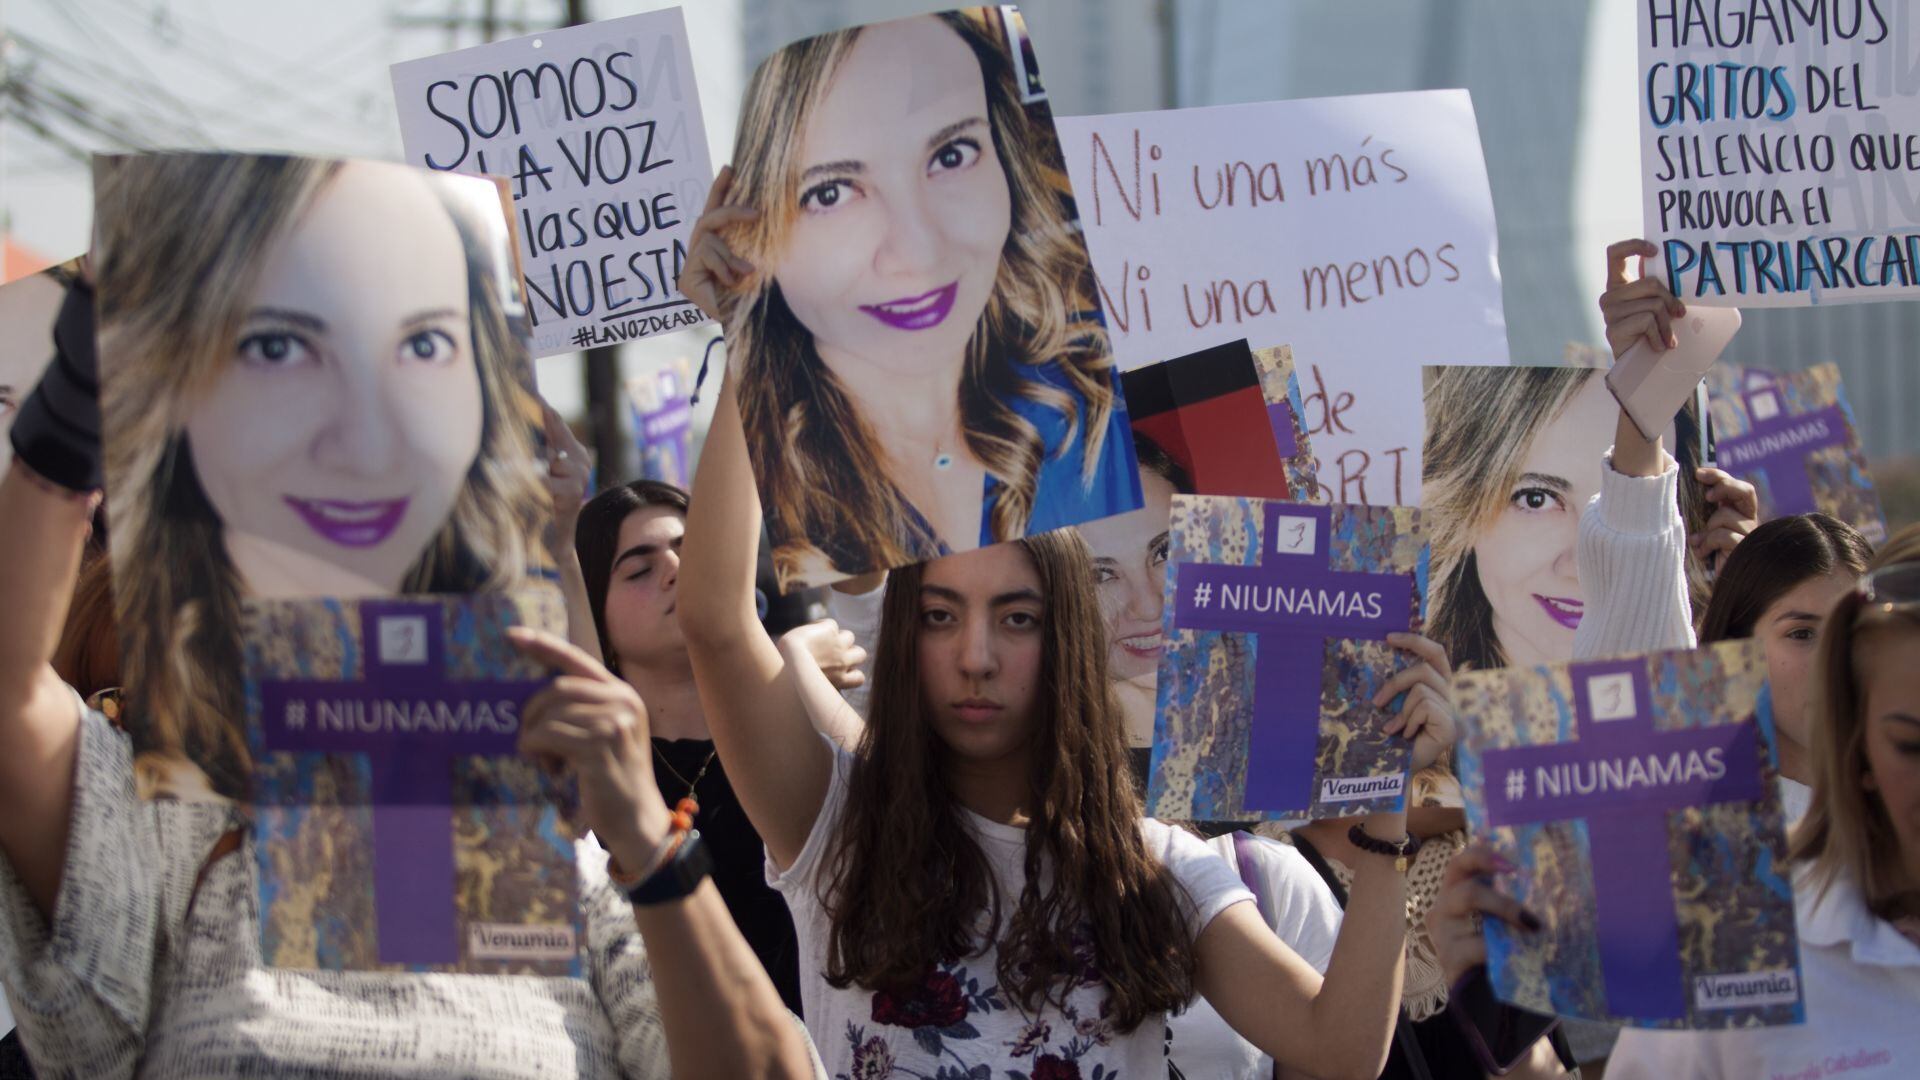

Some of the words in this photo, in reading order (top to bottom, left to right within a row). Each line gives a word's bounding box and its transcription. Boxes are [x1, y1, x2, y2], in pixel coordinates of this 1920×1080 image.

[1647, 61, 1797, 129] GRITOS
[1805, 62, 1880, 114] DEL
[557, 121, 673, 187] VOZ
[1092, 128, 1162, 226] Ni
[1193, 160, 1286, 210] una
[1306, 136, 1408, 195] más
[1655, 133, 1835, 182] SILENCIO
[1850, 133, 1920, 172] QUE
[1658, 189, 1794, 233] PROVOCA
[1184, 277, 1277, 329] una
[1303, 243, 1461, 310] menos
[1304, 365, 1356, 435] de
[1735, 418, 1830, 461] NIUNAMAS
[1220, 583, 1382, 618] NIUNAMAS
[316, 699, 520, 733] NIUNAMAS
[1323, 776, 1401, 795] Venumia
[1535, 747, 1727, 798] NIUNAMAS
[1698, 973, 1796, 998] Venumia
